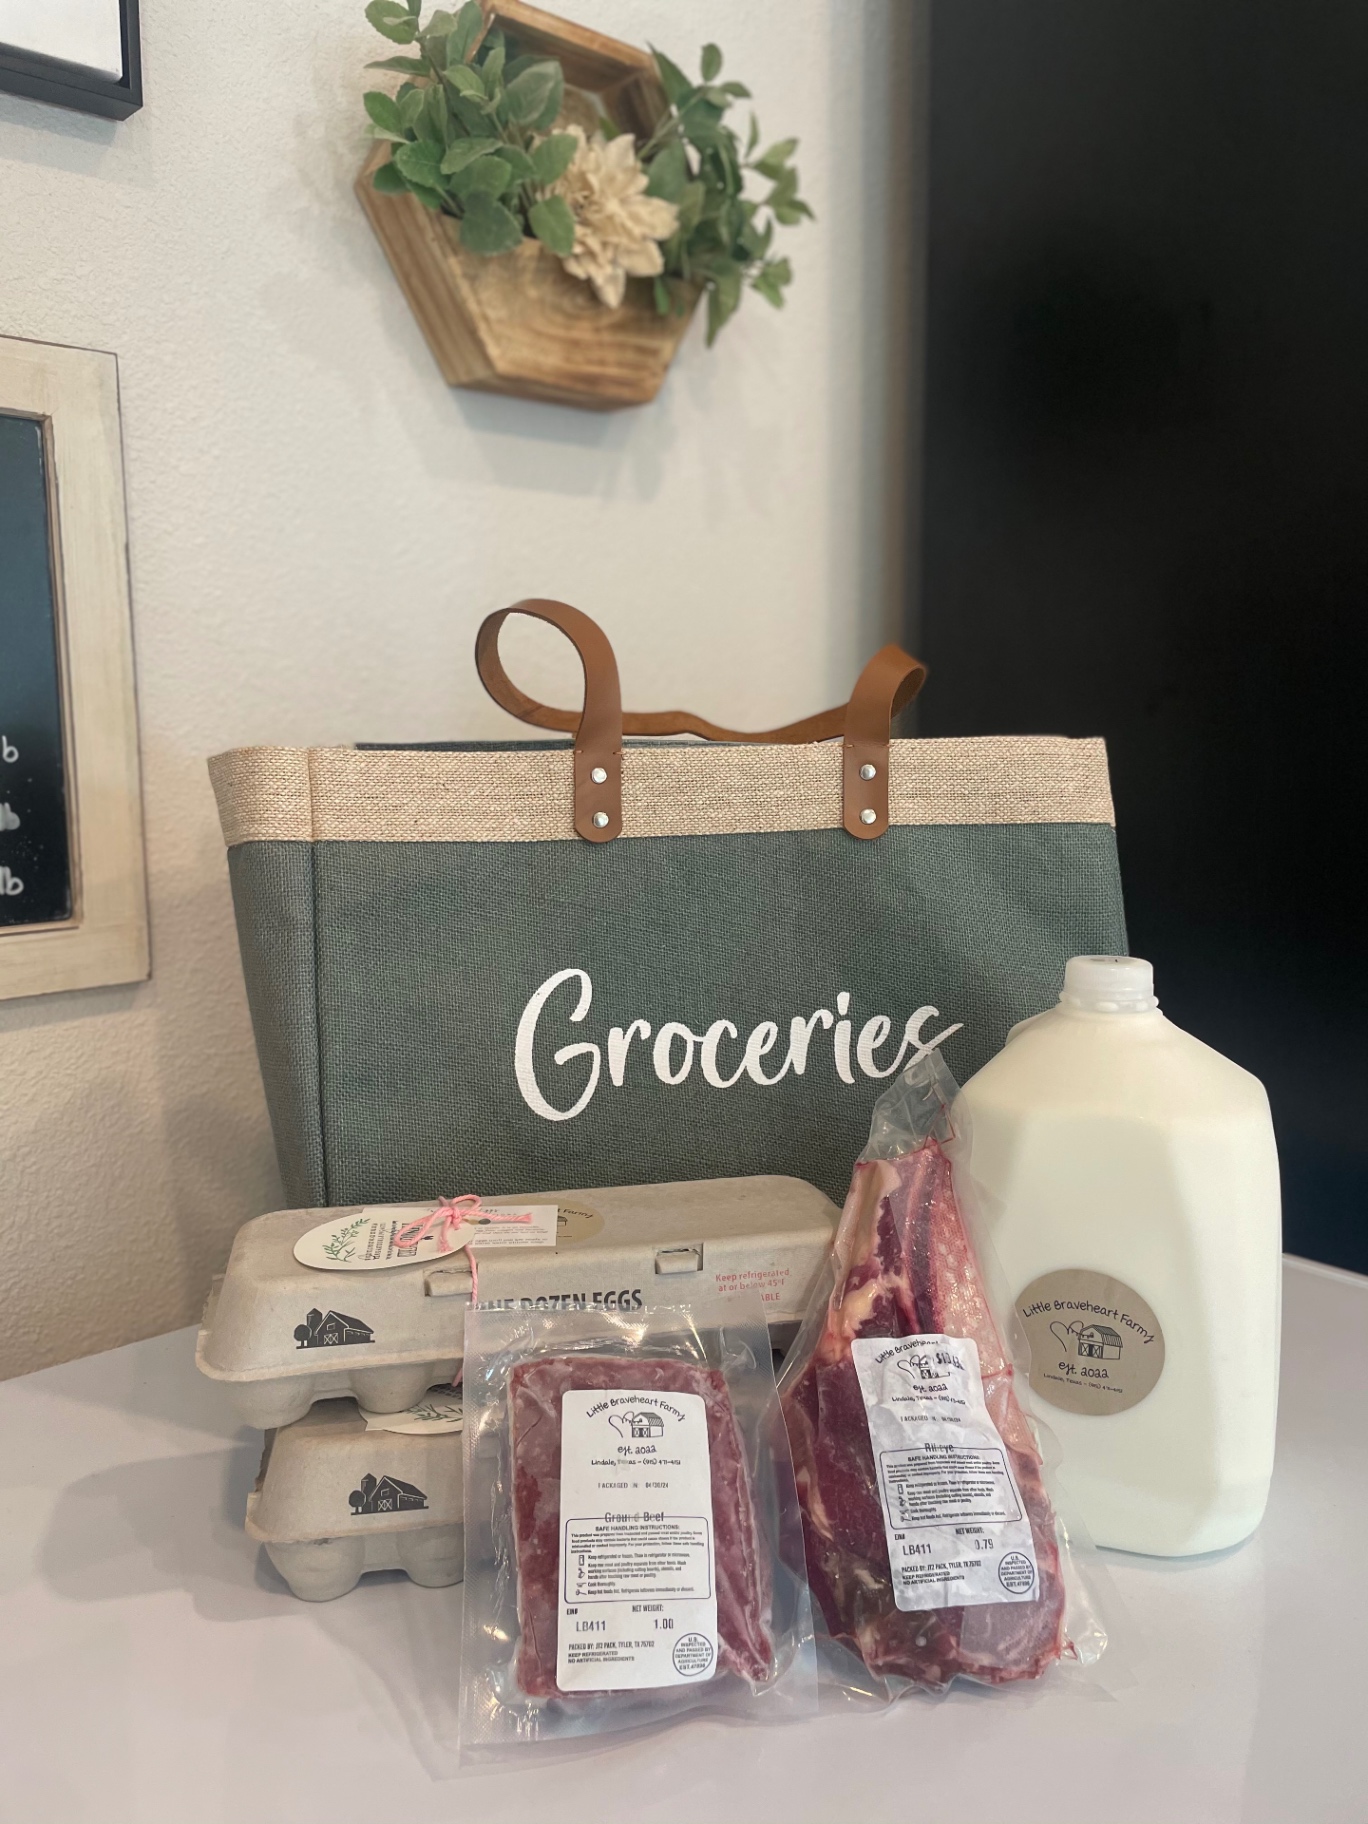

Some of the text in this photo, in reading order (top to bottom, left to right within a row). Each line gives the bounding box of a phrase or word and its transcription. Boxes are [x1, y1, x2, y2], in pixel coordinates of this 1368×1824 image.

[515, 968, 964, 1121] Groceries
[715, 1268, 790, 1283] Keep refrigerated
[728, 1283, 738, 1291] or
[592, 1288, 643, 1312] EGGS
[1022, 1300, 1051, 1318] Little
[1053, 1299, 1118, 1320] Braveheart
[875, 1349, 895, 1364] Little
[1080, 1366, 1109, 1379] 2022
[928, 1383, 949, 1393] 2022
[586, 1401, 610, 1418] Little
[610, 1395, 658, 1407] Braveheart
[635, 1445, 657, 1454] 2022
[591, 1458, 617, 1467] Lindale,
[643, 1511, 665, 1522] Beef
[902, 1543, 932, 1556] LB411
[975, 1538, 994, 1550] 0.79
[632, 1604, 664, 1612] NET WEIGHT:
[576, 1620, 606, 1632] LB411
[653, 1618, 674, 1630] 1.00
